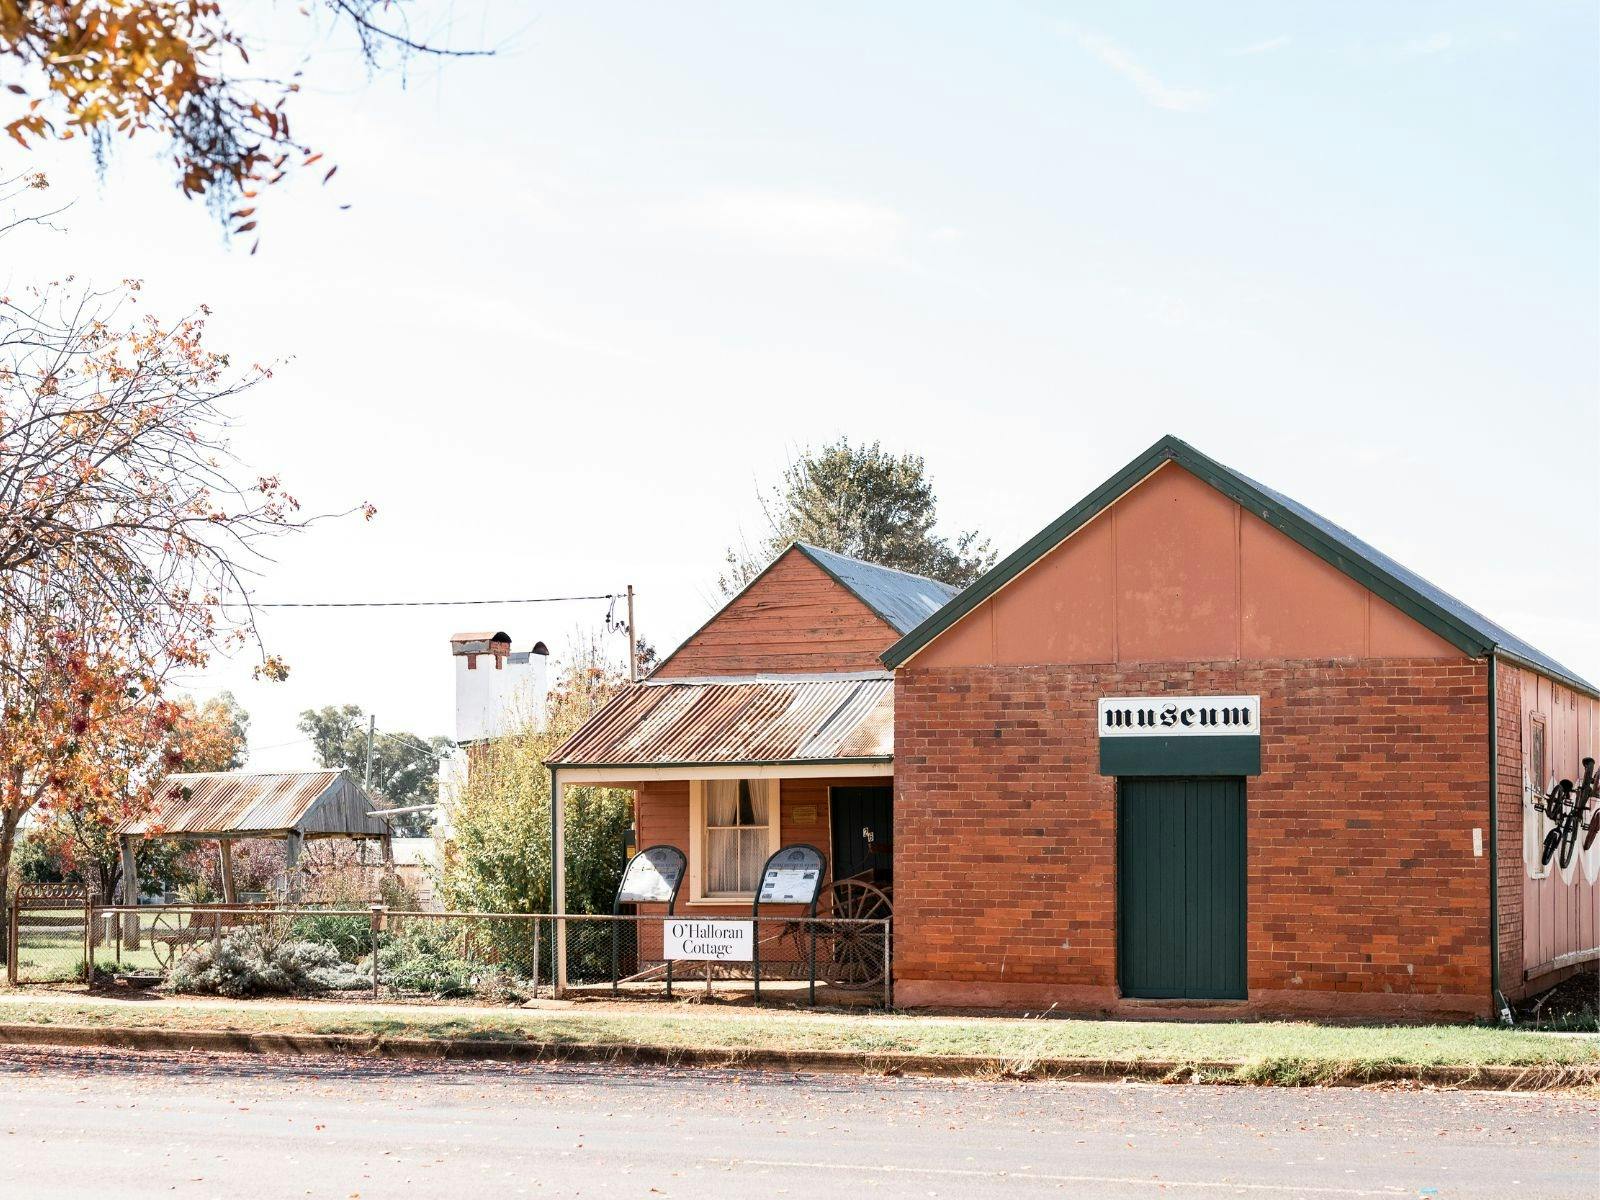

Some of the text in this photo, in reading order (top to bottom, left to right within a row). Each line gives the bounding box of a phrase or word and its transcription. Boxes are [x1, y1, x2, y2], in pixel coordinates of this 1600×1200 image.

[1105, 703, 1251, 728] museum
[672, 923, 743, 939] O'Halloran
[682, 939, 733, 959] Cottage
